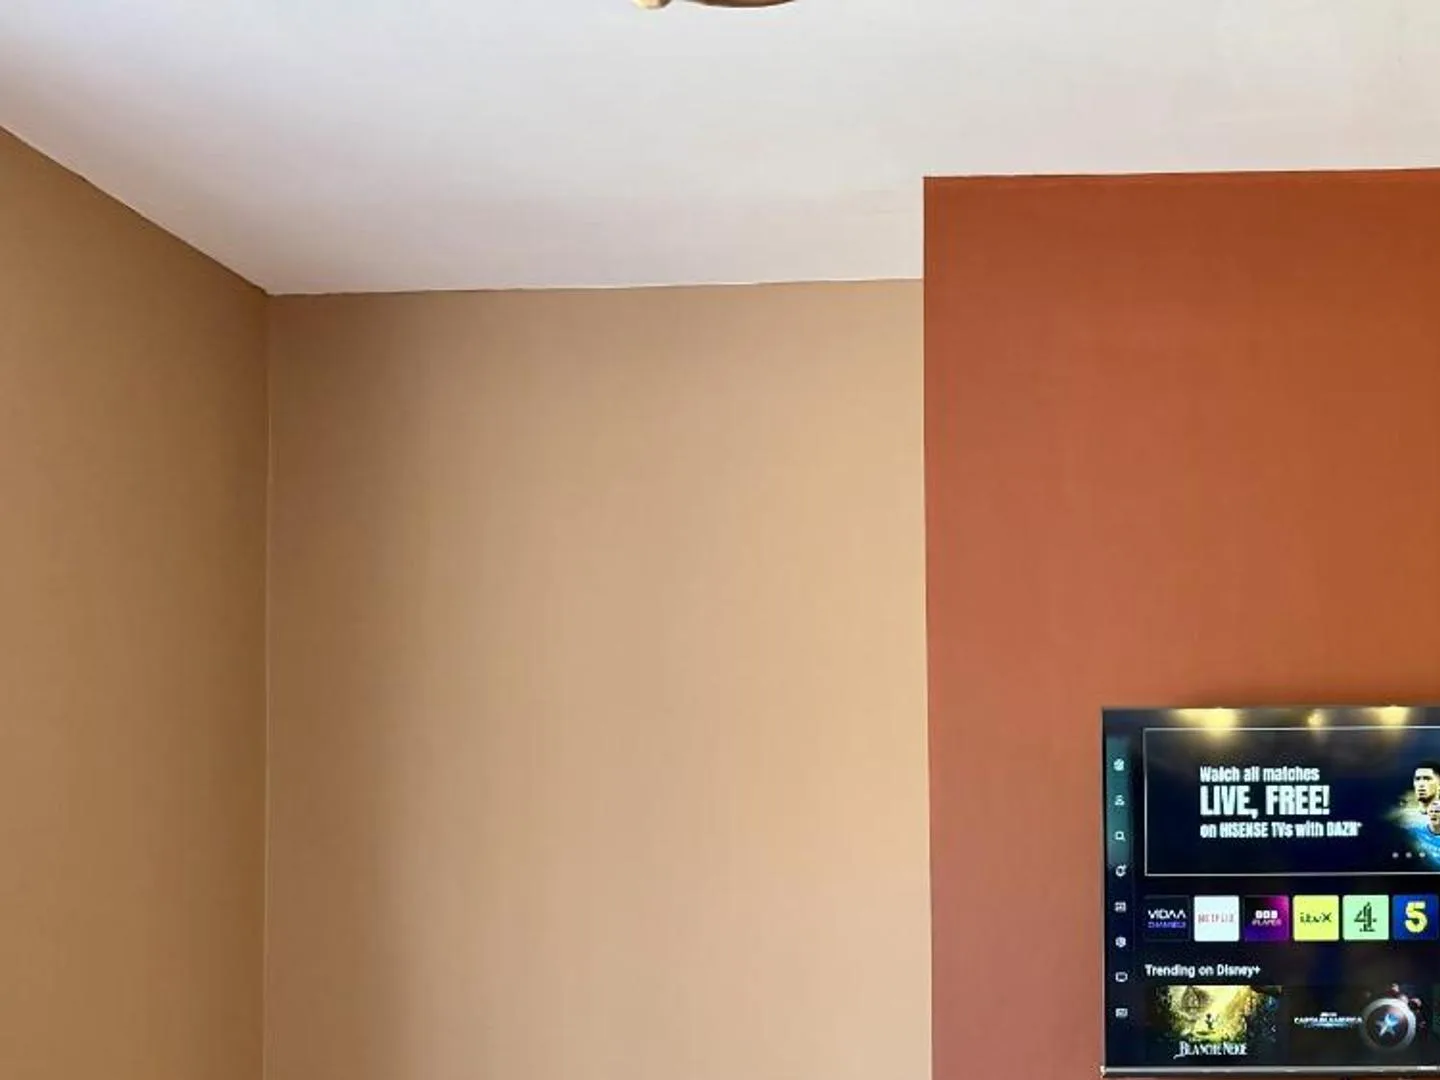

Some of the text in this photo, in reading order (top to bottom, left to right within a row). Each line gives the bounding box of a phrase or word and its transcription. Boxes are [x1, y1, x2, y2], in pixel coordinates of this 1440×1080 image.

[1200, 766, 1320, 783] Watch all matches
[1200, 785, 1330, 819] LIVE, FREE!
[1200, 824, 1217, 838] on
[1219, 822, 1268, 838] HISENSE
[1271, 822, 1293, 837] TVs
[1296, 820, 1324, 837] with
[1354, 902, 1377, 932] 4
[1405, 901, 1428, 933] 5
[1145, 964, 1261, 979] Trending on Disney+
